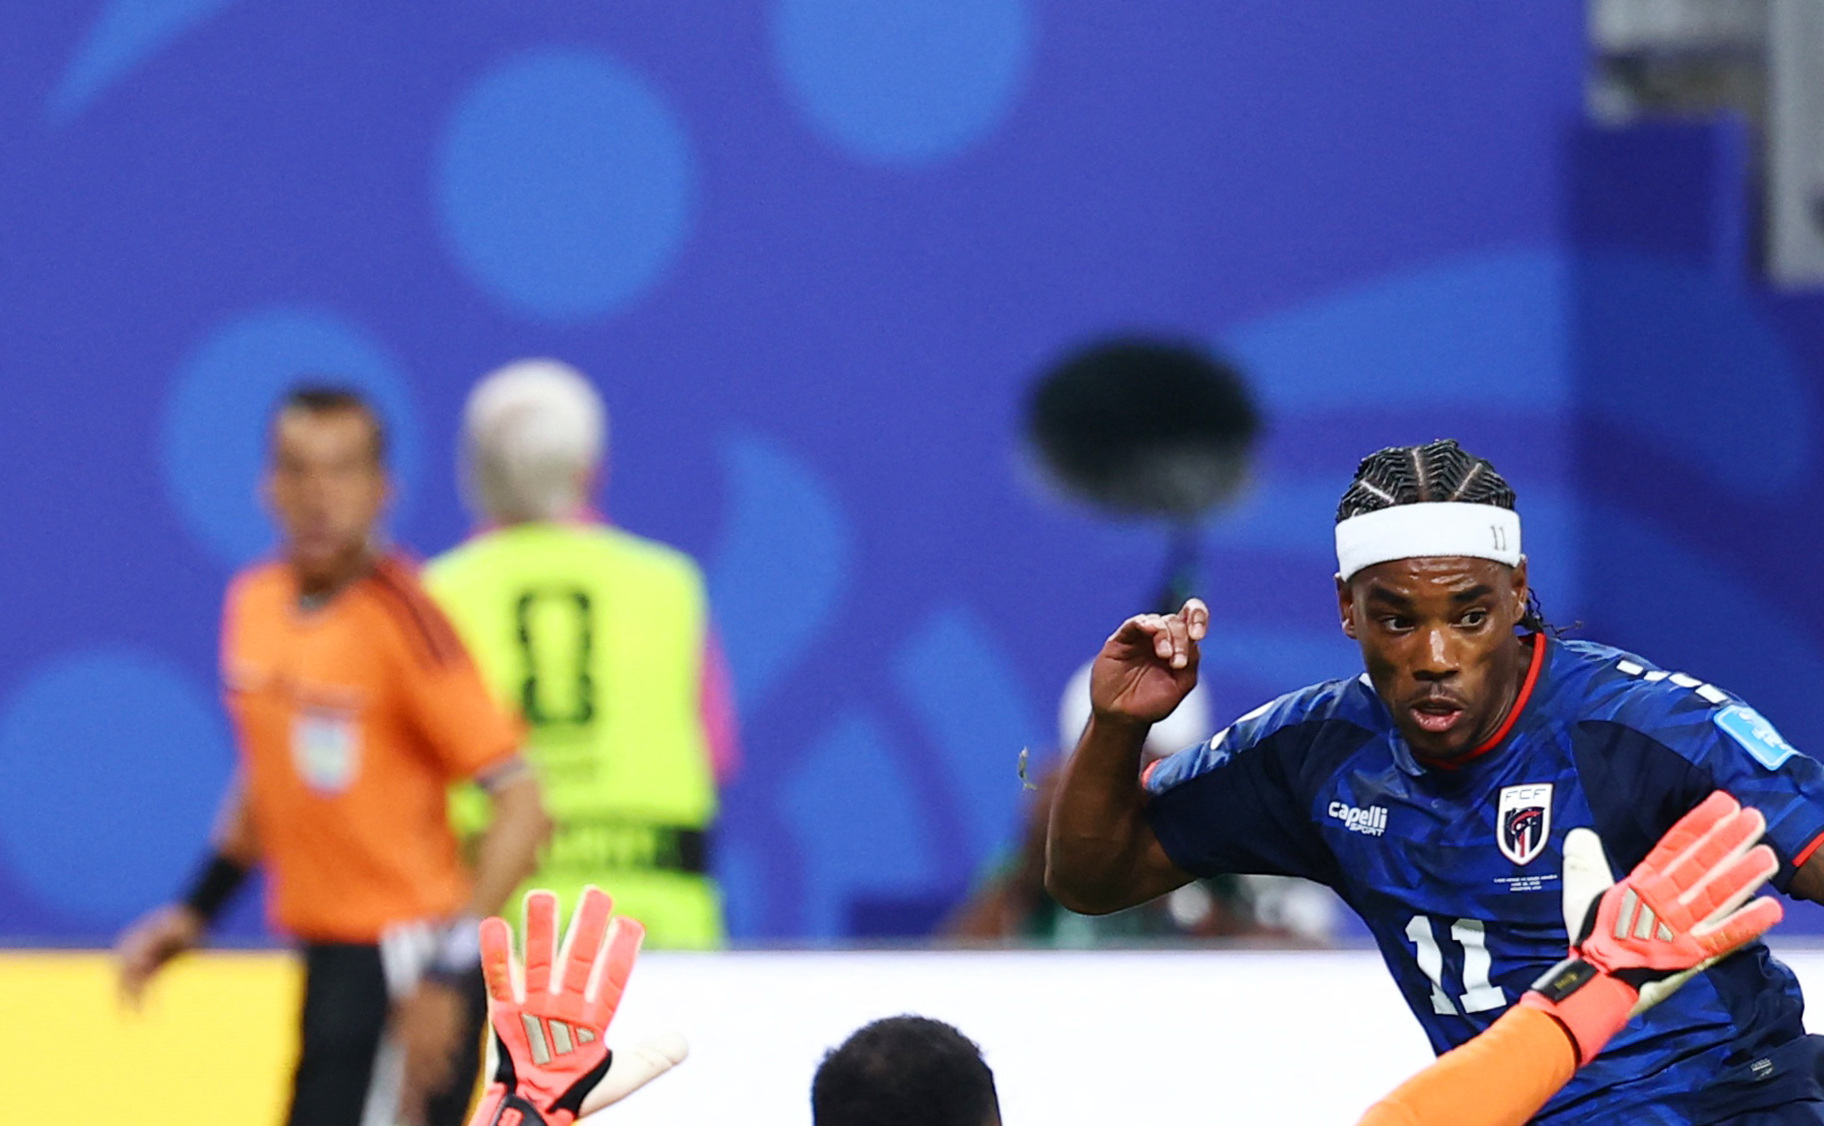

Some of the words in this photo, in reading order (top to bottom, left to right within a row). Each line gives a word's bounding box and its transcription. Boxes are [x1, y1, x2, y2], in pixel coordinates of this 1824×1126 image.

[1505, 788, 1546, 802] FCF
[1328, 801, 1388, 829] capelli
[1349, 822, 1385, 837] SPORT
[1405, 915, 1507, 1016] 11
